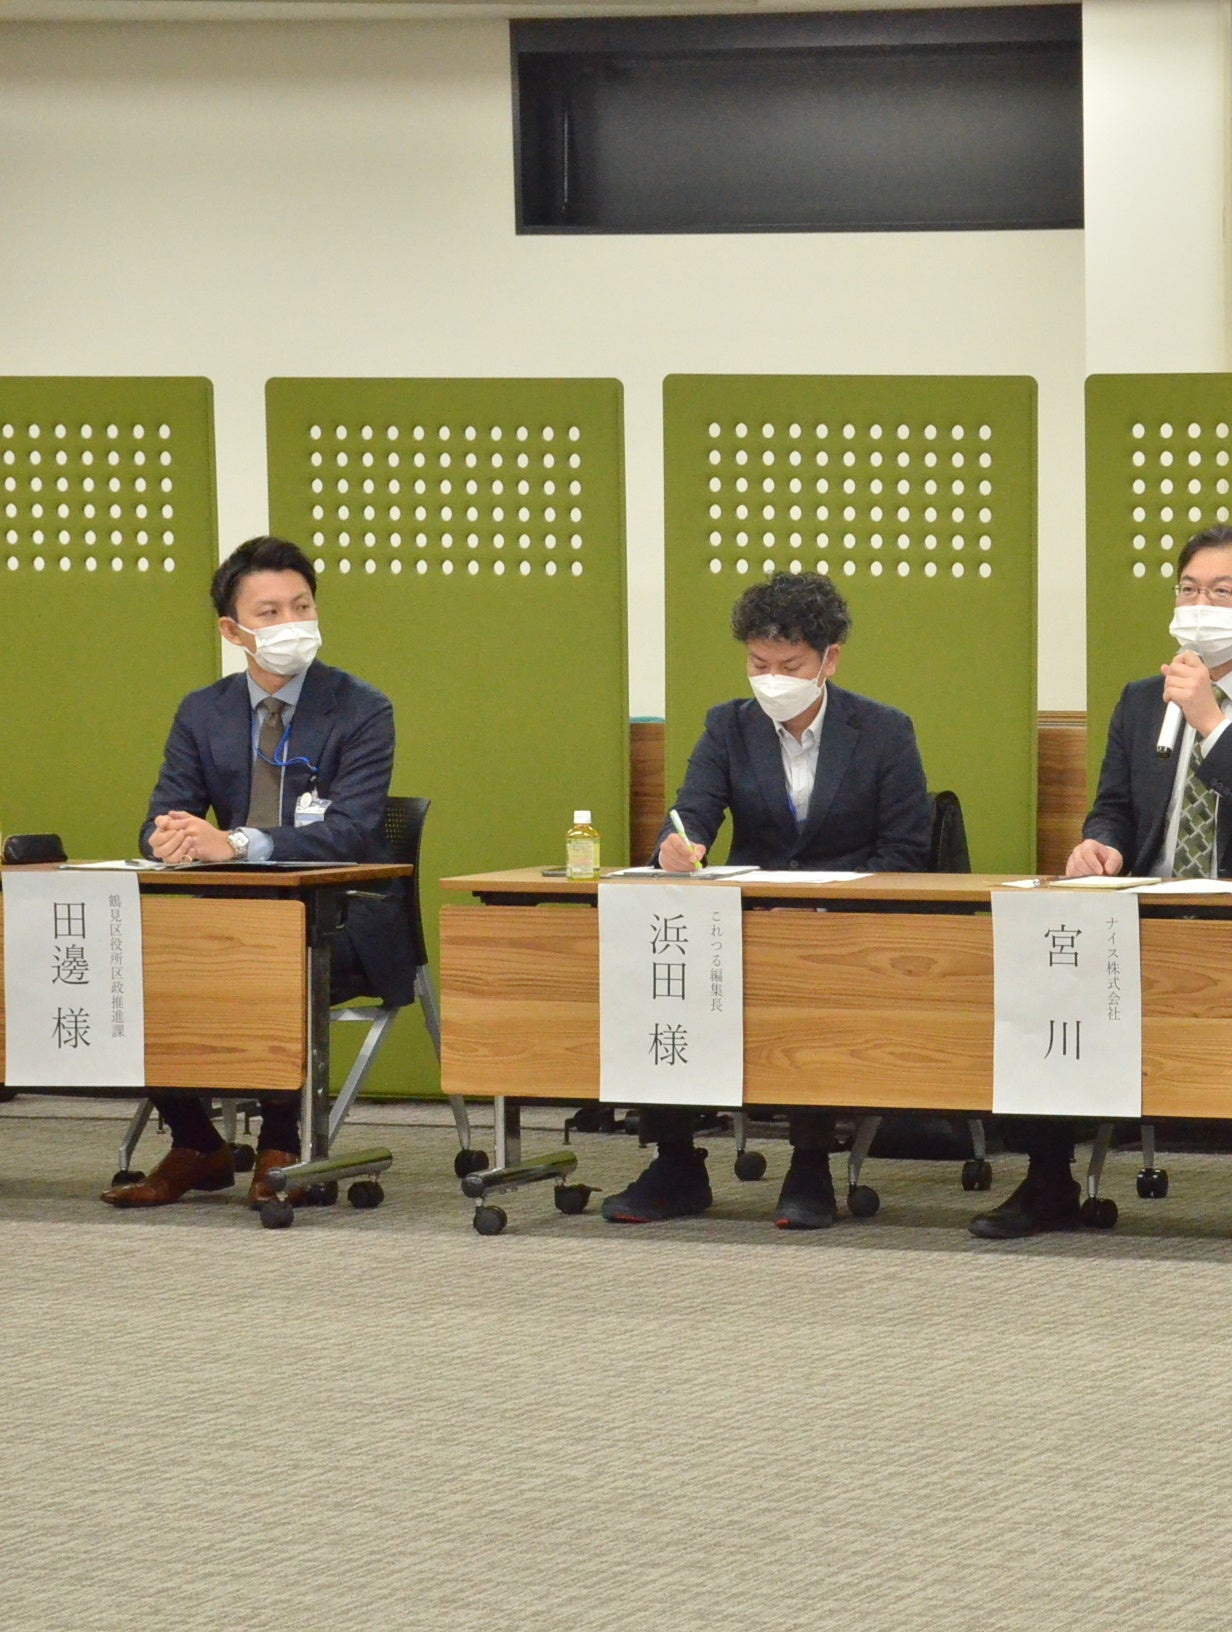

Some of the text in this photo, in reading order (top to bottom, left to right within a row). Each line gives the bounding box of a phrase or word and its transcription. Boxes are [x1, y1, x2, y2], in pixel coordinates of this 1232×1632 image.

[108, 894, 125, 1038] 鶴見区役所区政推進課
[710, 911, 724, 1012] これつる編集長
[1106, 917, 1121, 1021] ナイス株式会社
